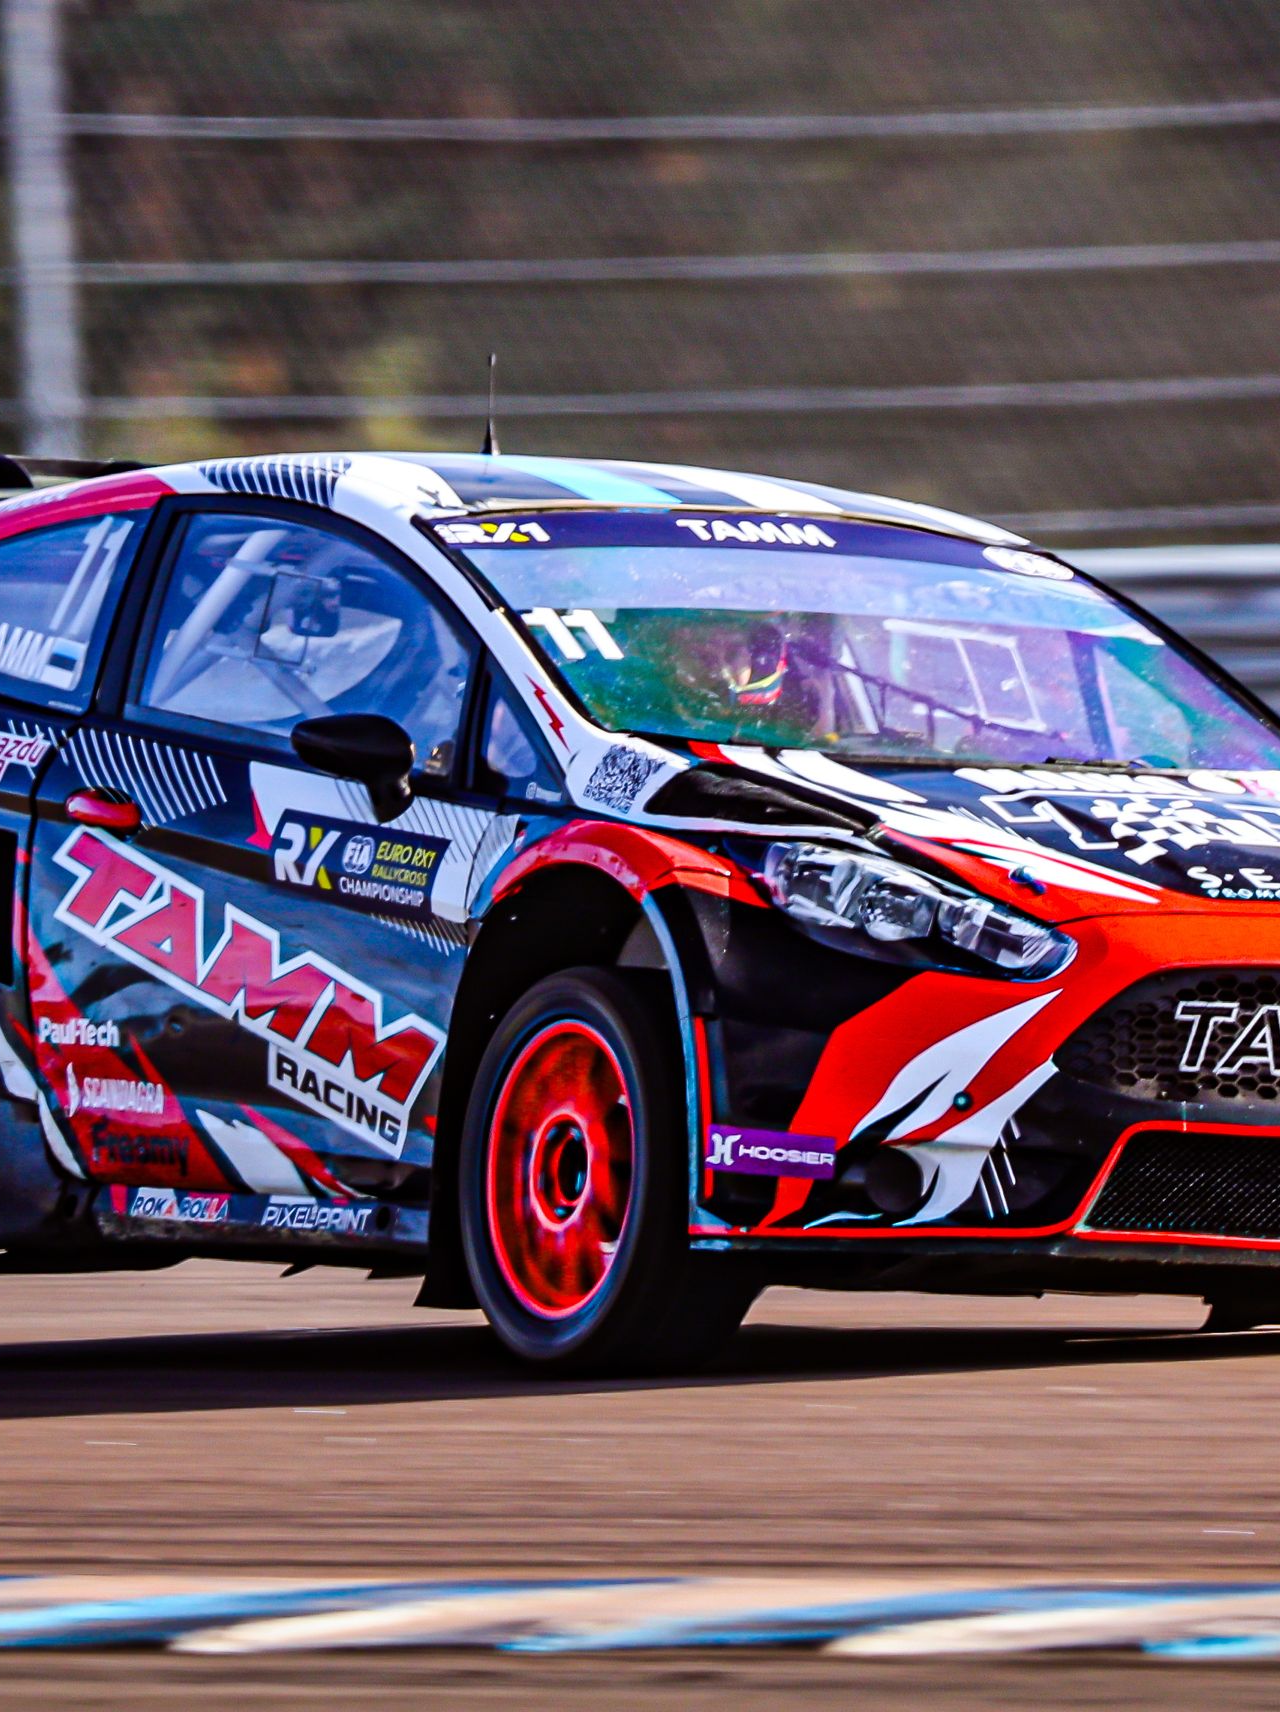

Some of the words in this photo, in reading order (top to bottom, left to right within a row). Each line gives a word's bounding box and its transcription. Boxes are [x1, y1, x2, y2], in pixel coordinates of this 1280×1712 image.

[676, 519, 837, 548] TAMM
[49, 515, 134, 635] 11
[521, 607, 623, 660] 11
[274, 822, 342, 890] RX
[376, 840, 413, 864] EURO
[411, 846, 438, 870] RX1
[338, 875, 425, 907] CHAMPIONSHIP
[371, 863, 428, 887] RALLYCROSS
[61, 828, 442, 1104] TAMM
[276, 1054, 401, 1145] RACING
[738, 1144, 836, 1167] HOOSIER
[261, 1205, 373, 1234] PIXELPRINT
